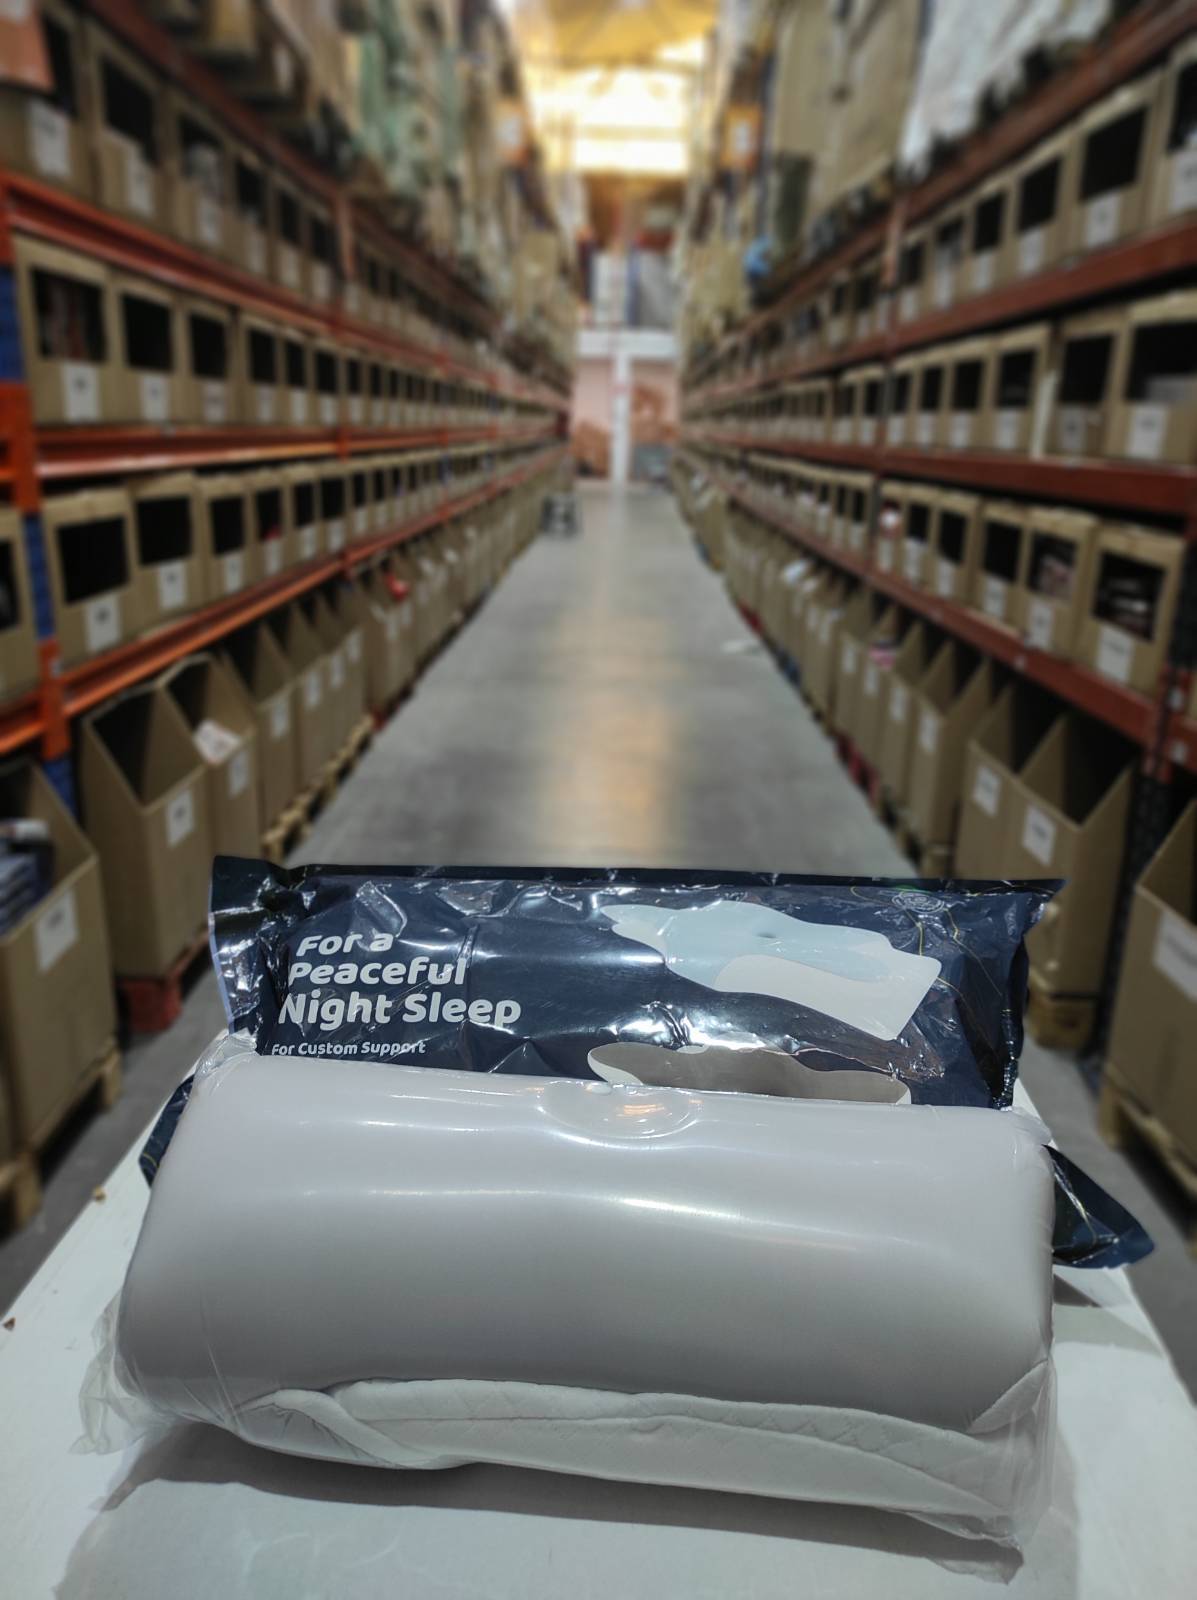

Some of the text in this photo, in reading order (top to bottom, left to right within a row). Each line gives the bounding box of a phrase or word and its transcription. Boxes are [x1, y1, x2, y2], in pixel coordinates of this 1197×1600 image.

[296, 934, 393, 956] For a
[288, 956, 467, 985] Peaceful
[278, 988, 521, 1031] Night Sleep
[271, 1041, 426, 1056] For Custom Support
